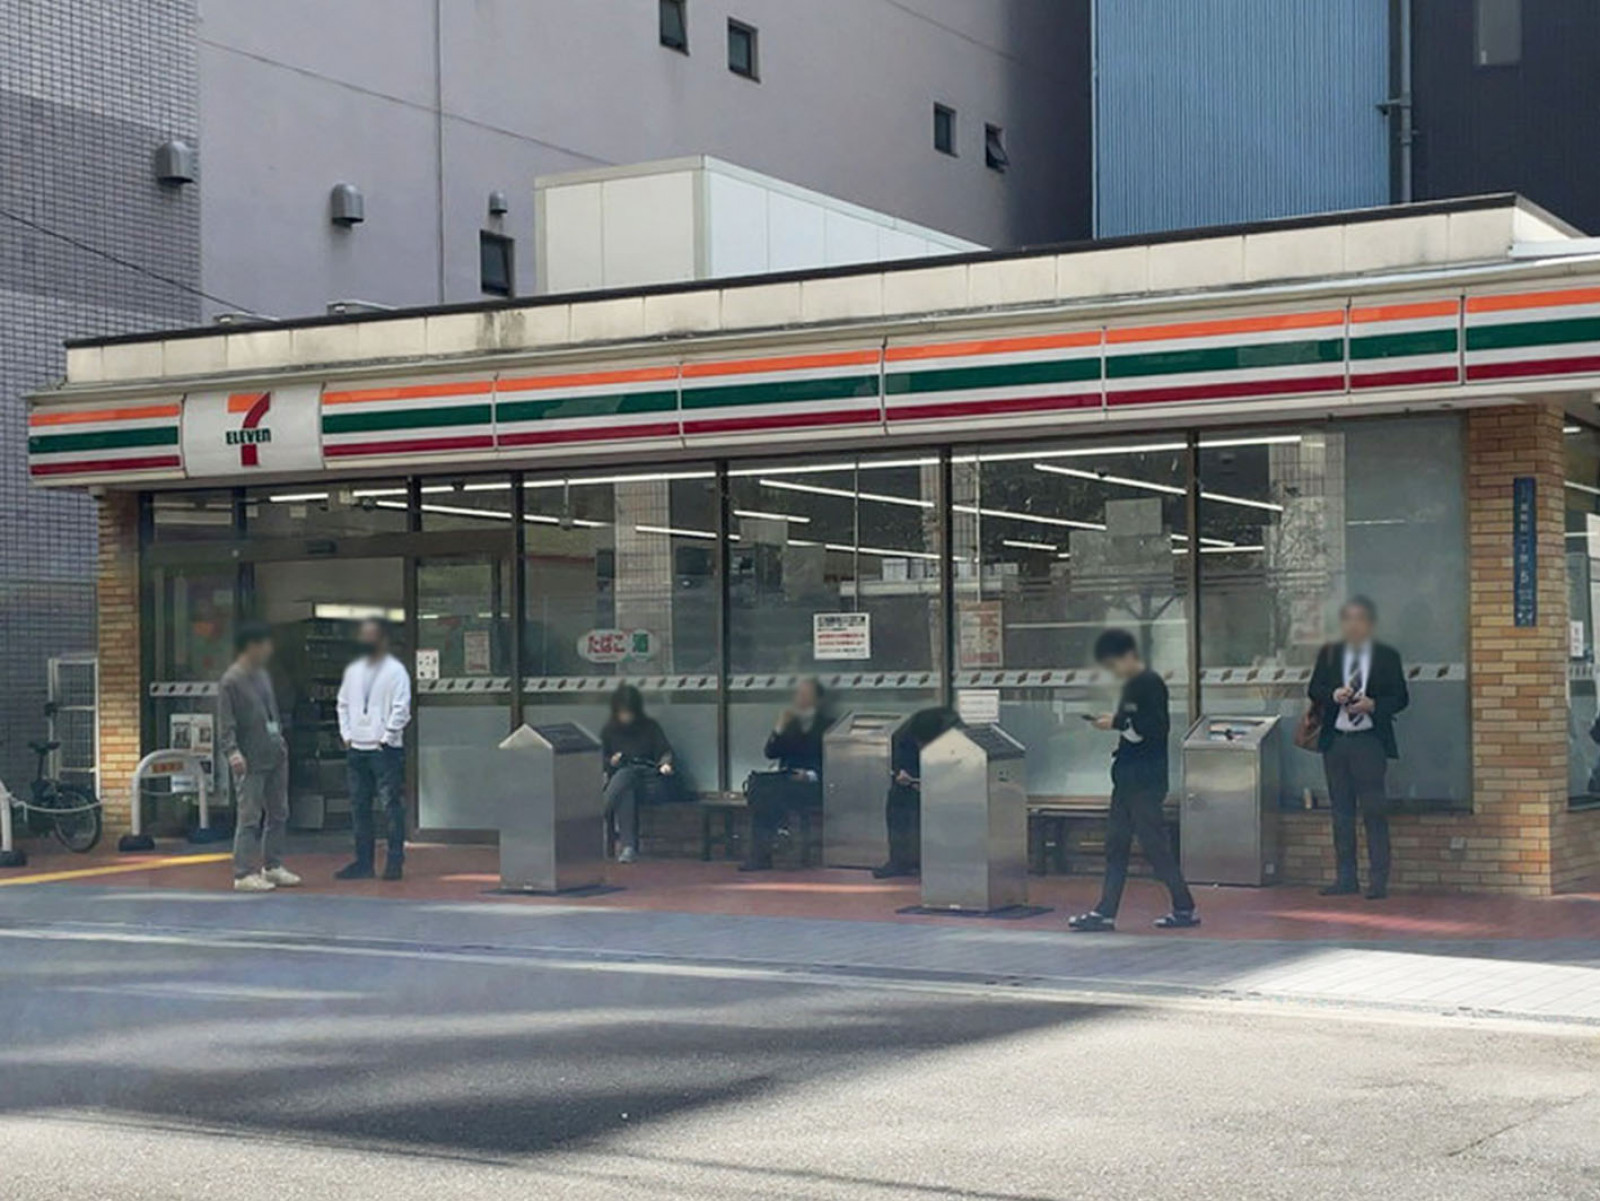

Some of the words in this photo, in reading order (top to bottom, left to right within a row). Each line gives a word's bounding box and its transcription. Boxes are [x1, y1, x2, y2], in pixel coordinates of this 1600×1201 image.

[228, 391, 271, 466] 7
[588, 633, 625, 653] たばこ
